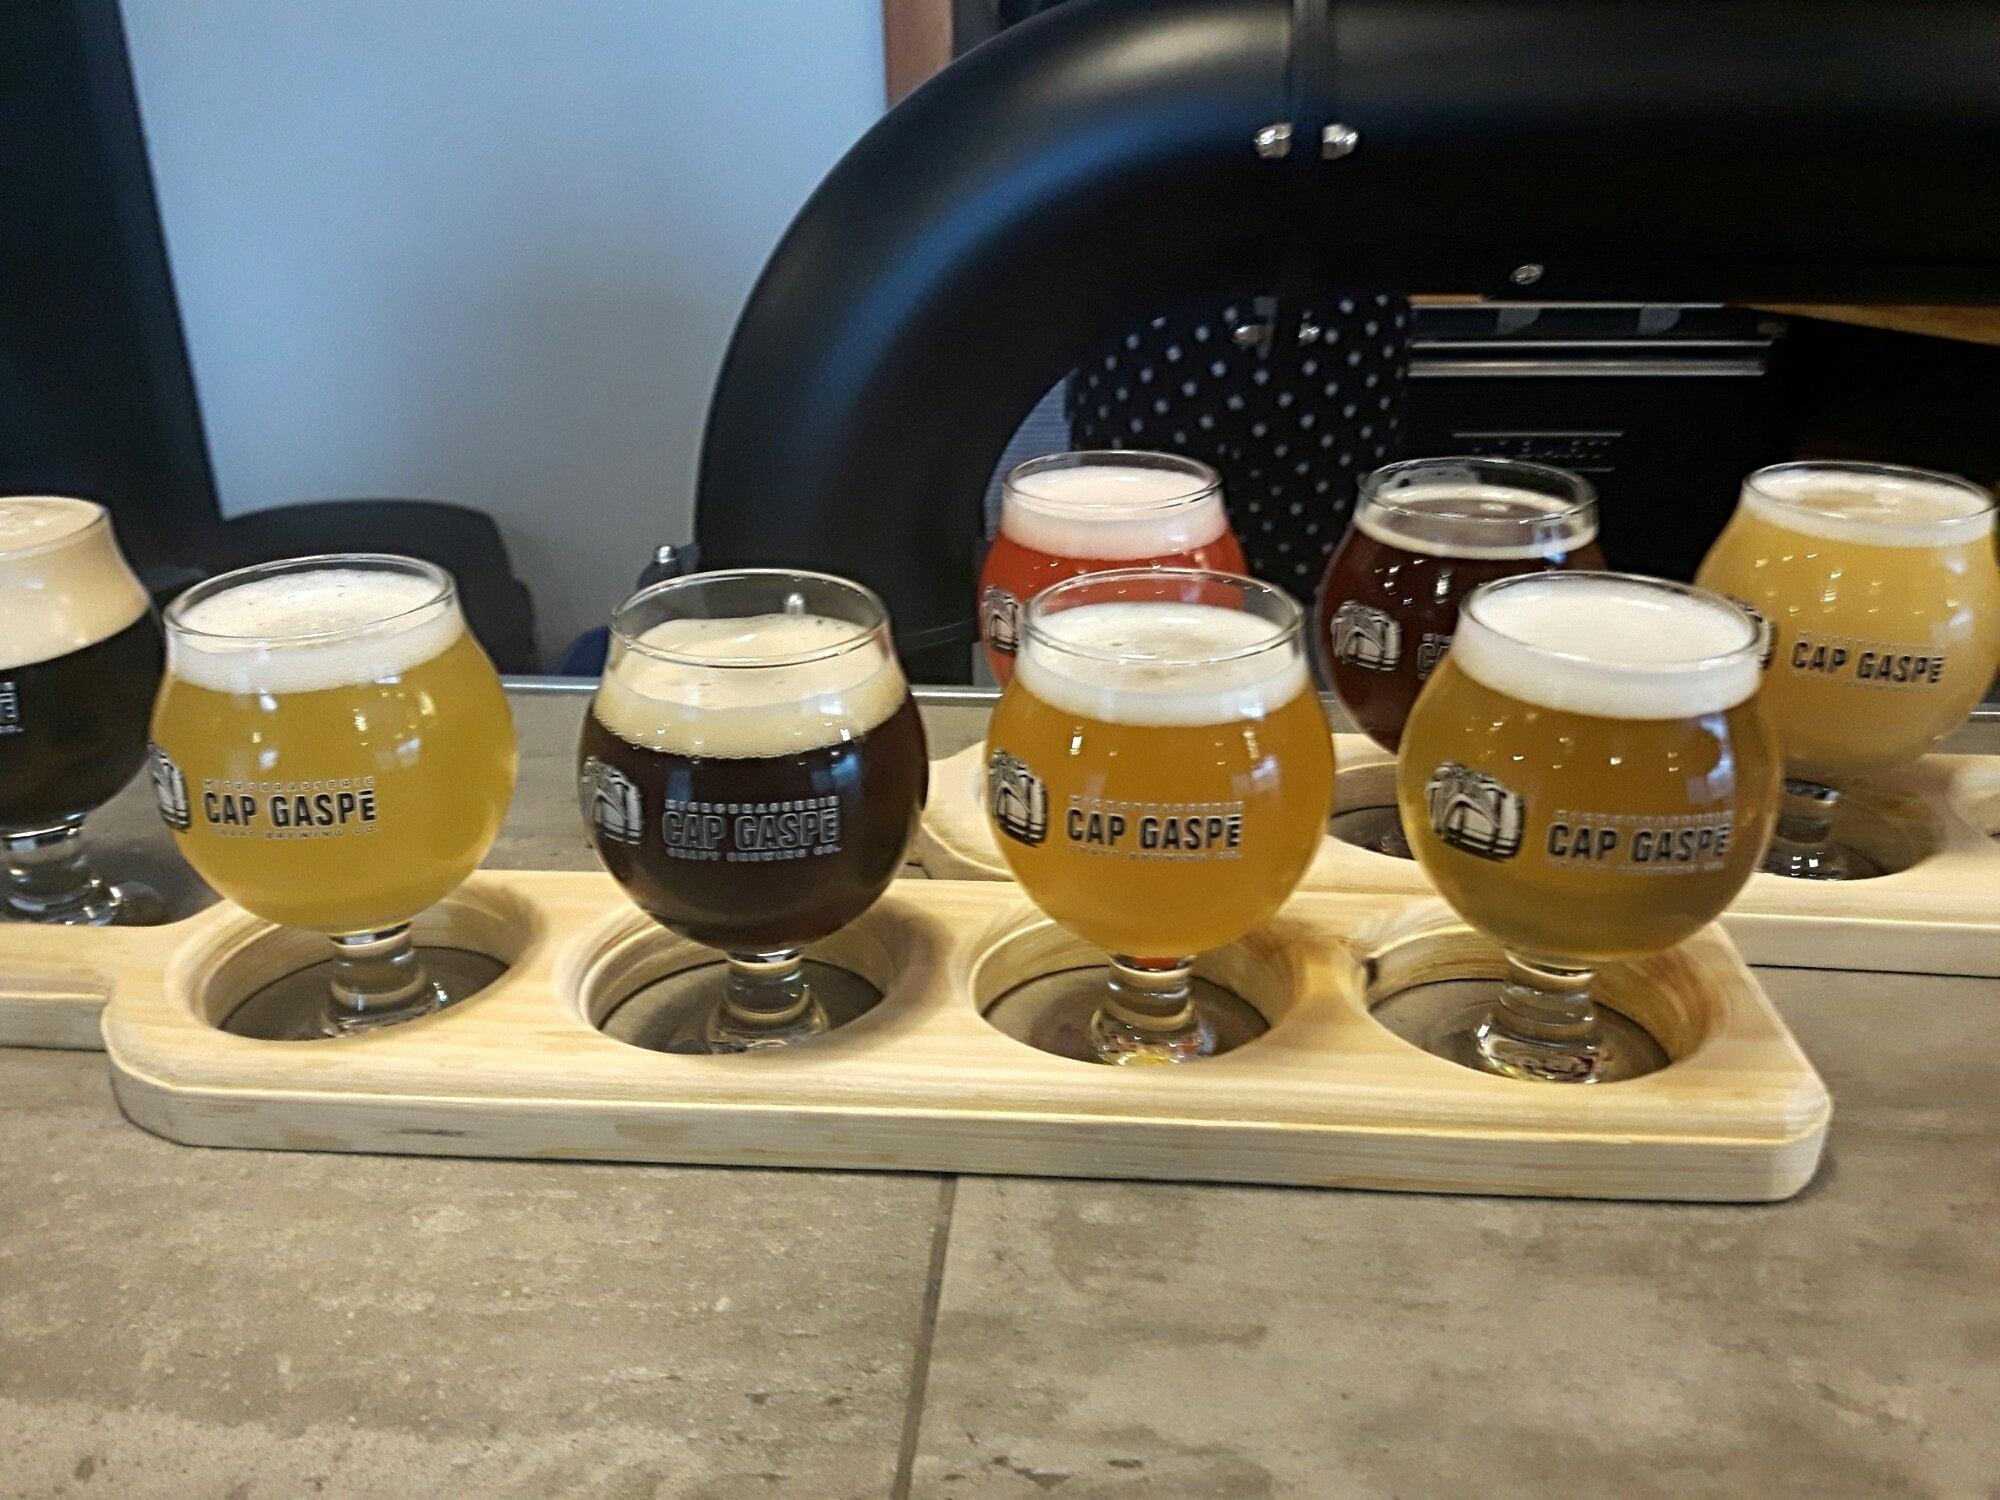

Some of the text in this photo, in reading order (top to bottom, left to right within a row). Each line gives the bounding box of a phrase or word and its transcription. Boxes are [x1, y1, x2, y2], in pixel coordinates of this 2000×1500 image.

[1791, 640, 1847, 674] CAP
[202, 791, 258, 827] CAP
[1067, 807, 1127, 846] CAP
[662, 811, 727, 850] CAP
[1546, 822, 1618, 861] CAP
